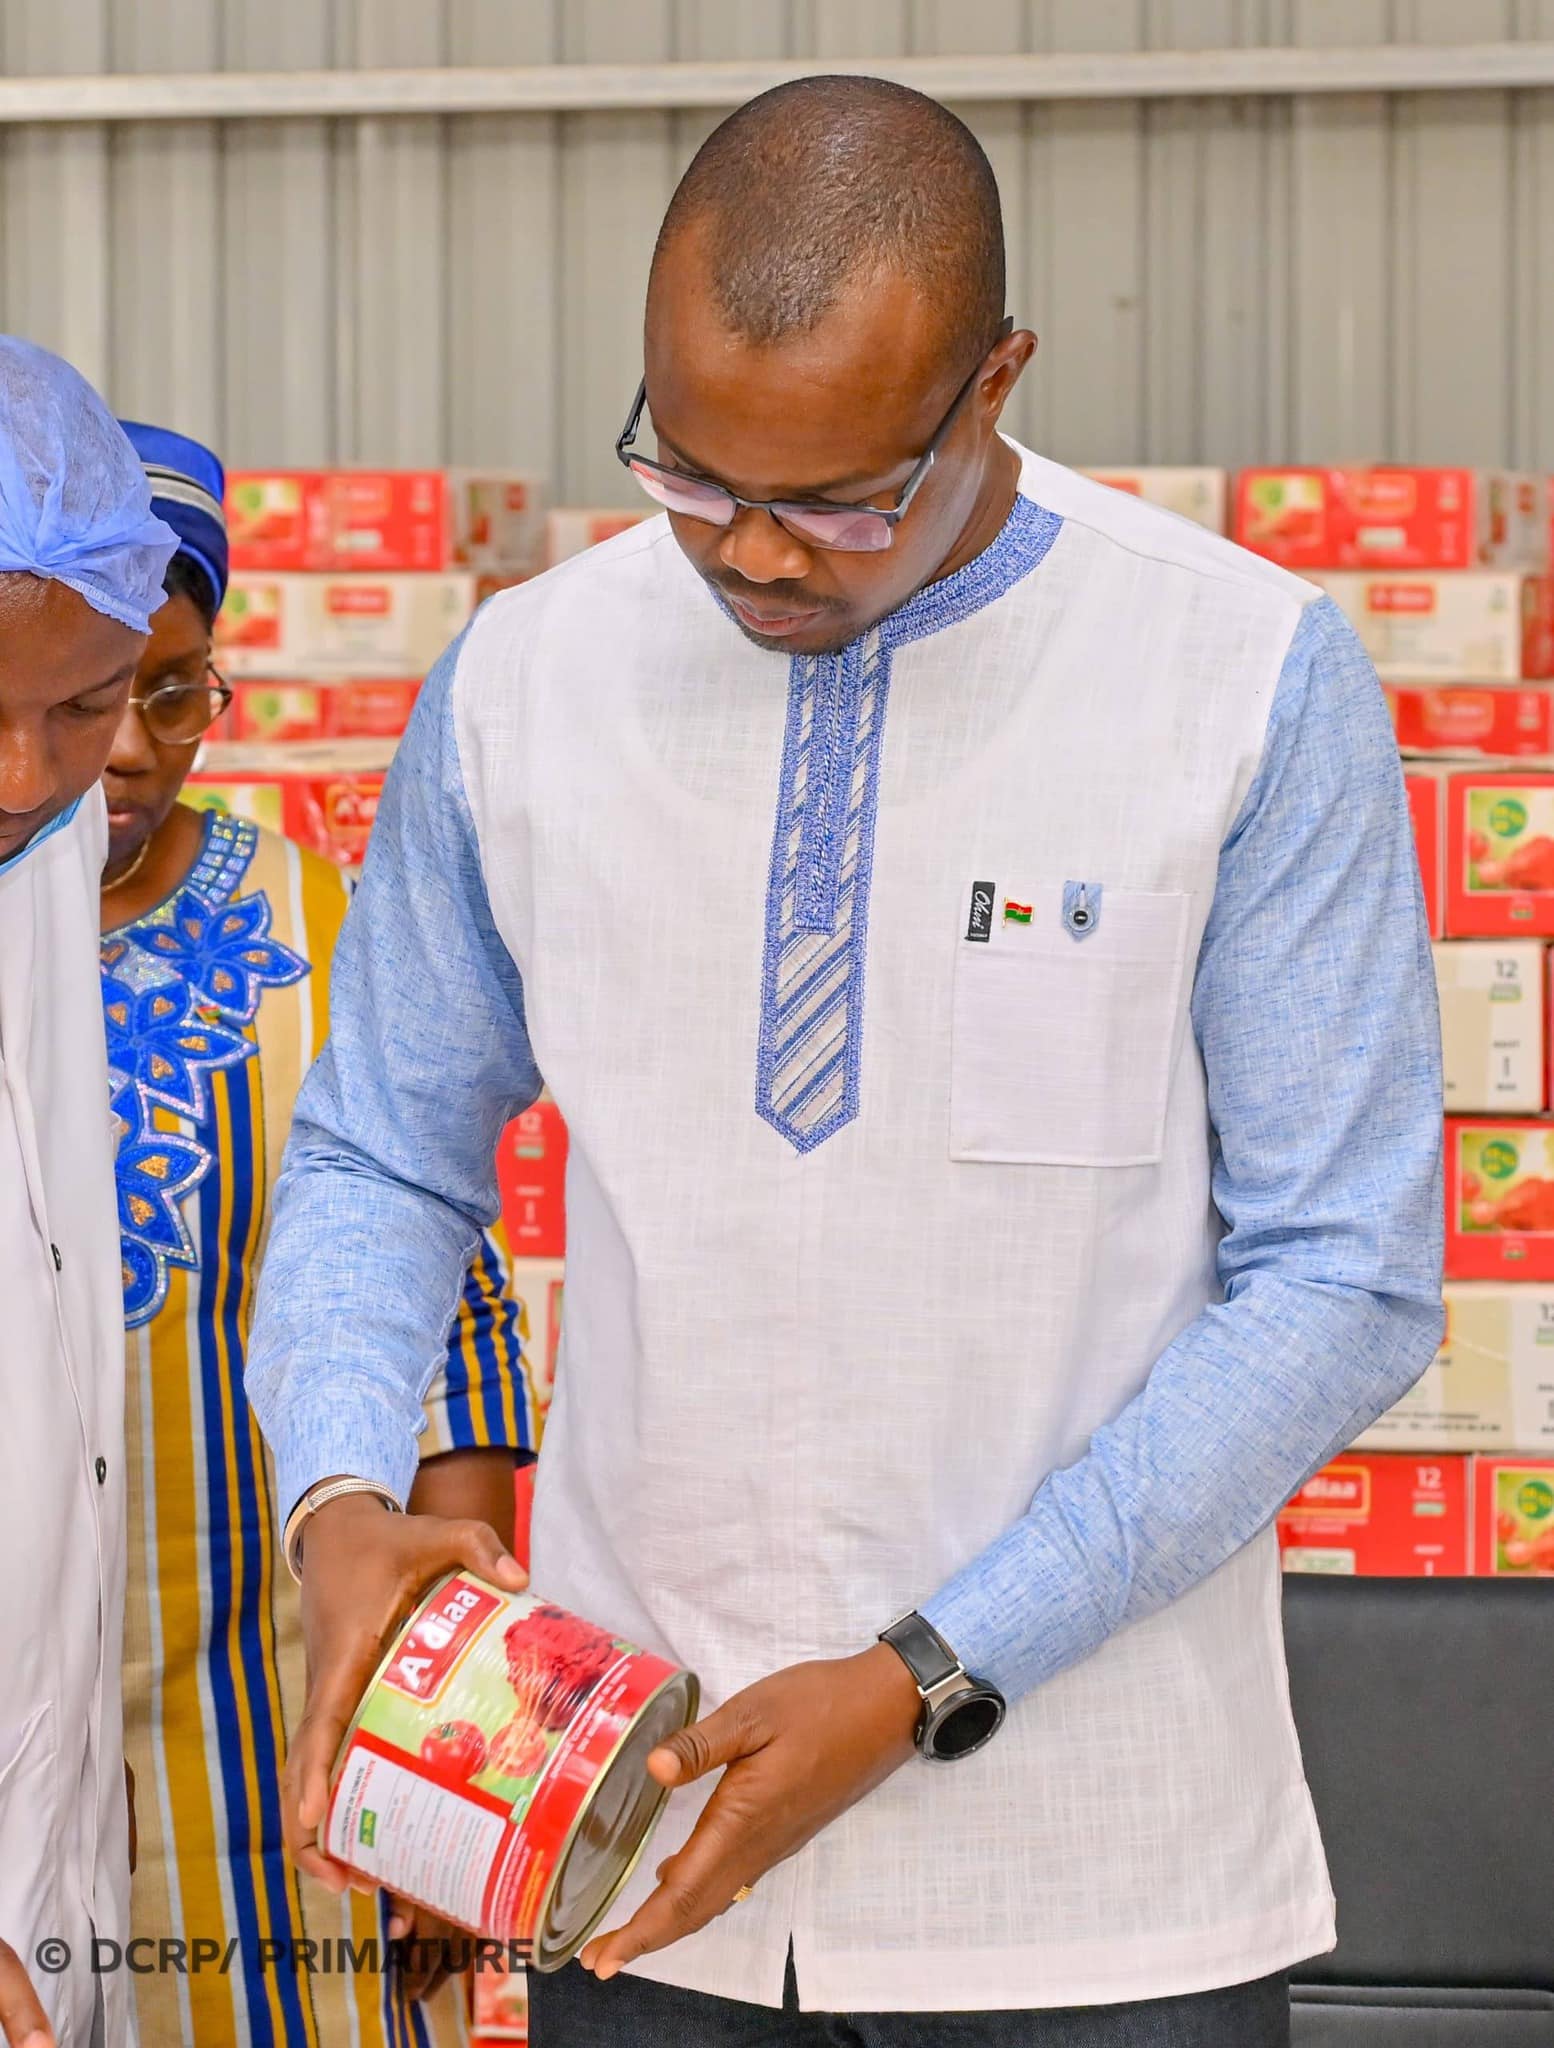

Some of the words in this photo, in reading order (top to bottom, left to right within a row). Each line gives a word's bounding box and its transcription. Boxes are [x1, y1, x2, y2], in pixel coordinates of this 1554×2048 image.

[1496, 959, 1518, 978] 12
[1302, 1477, 1357, 1499] diaa
[1416, 1466, 1441, 1488] 12
[398, 1588, 481, 1691] A'diaa
